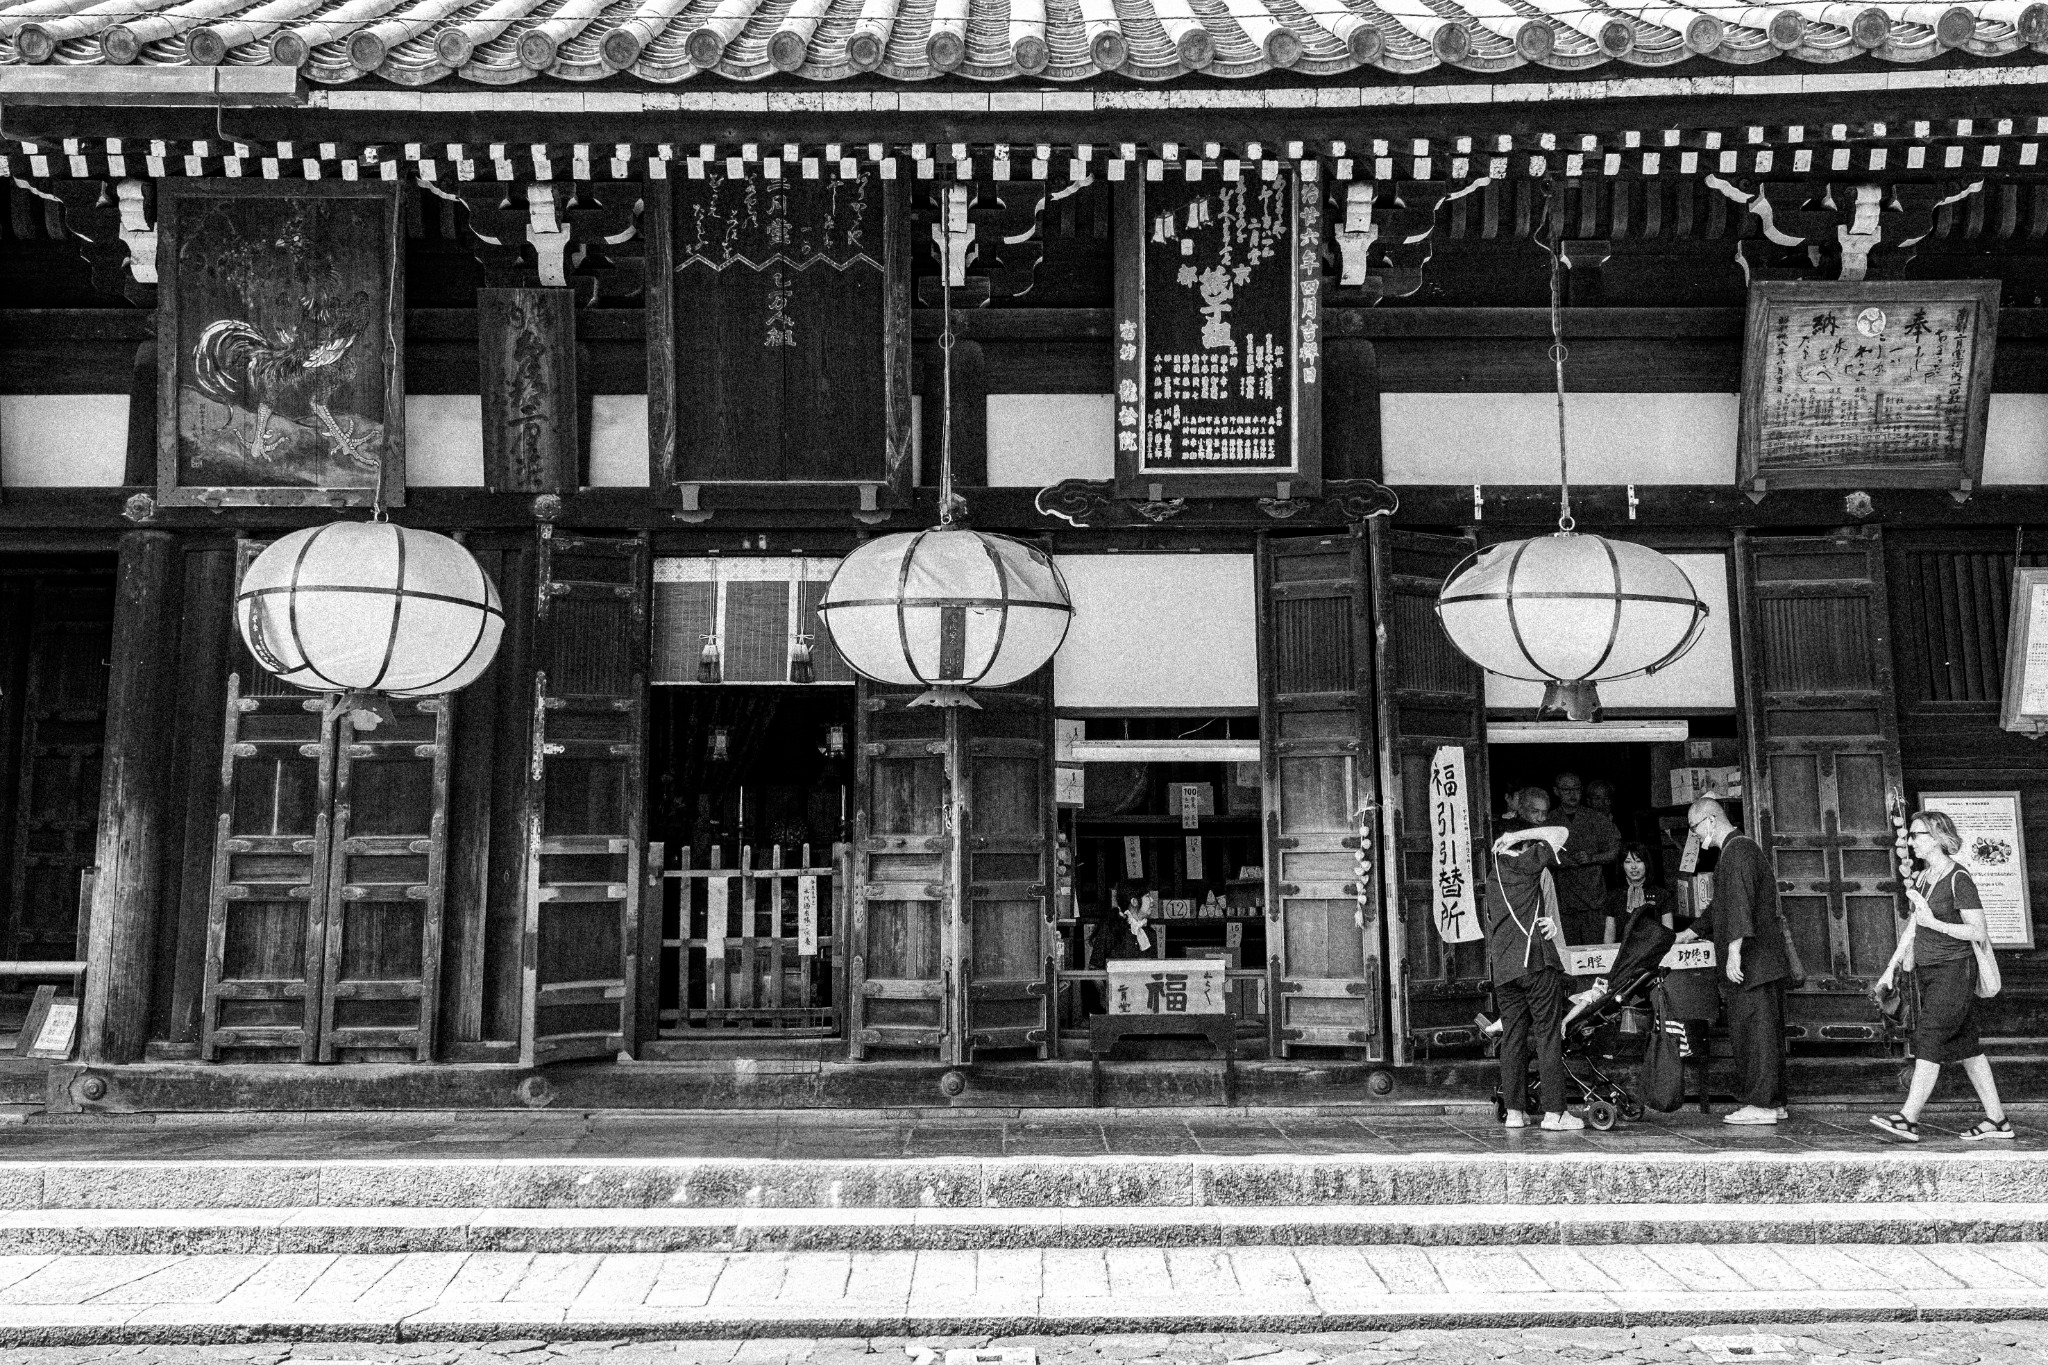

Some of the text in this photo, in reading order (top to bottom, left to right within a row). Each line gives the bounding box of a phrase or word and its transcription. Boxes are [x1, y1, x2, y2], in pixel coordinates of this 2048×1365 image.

[1812, 308, 1932, 343] 奉 納
[1183, 787, 1197, 796] 100
[1431, 763, 1465, 939] 福引引替所
[1117, 984, 1132, 1013] 二月堂
[1145, 973, 1189, 1014] 福
